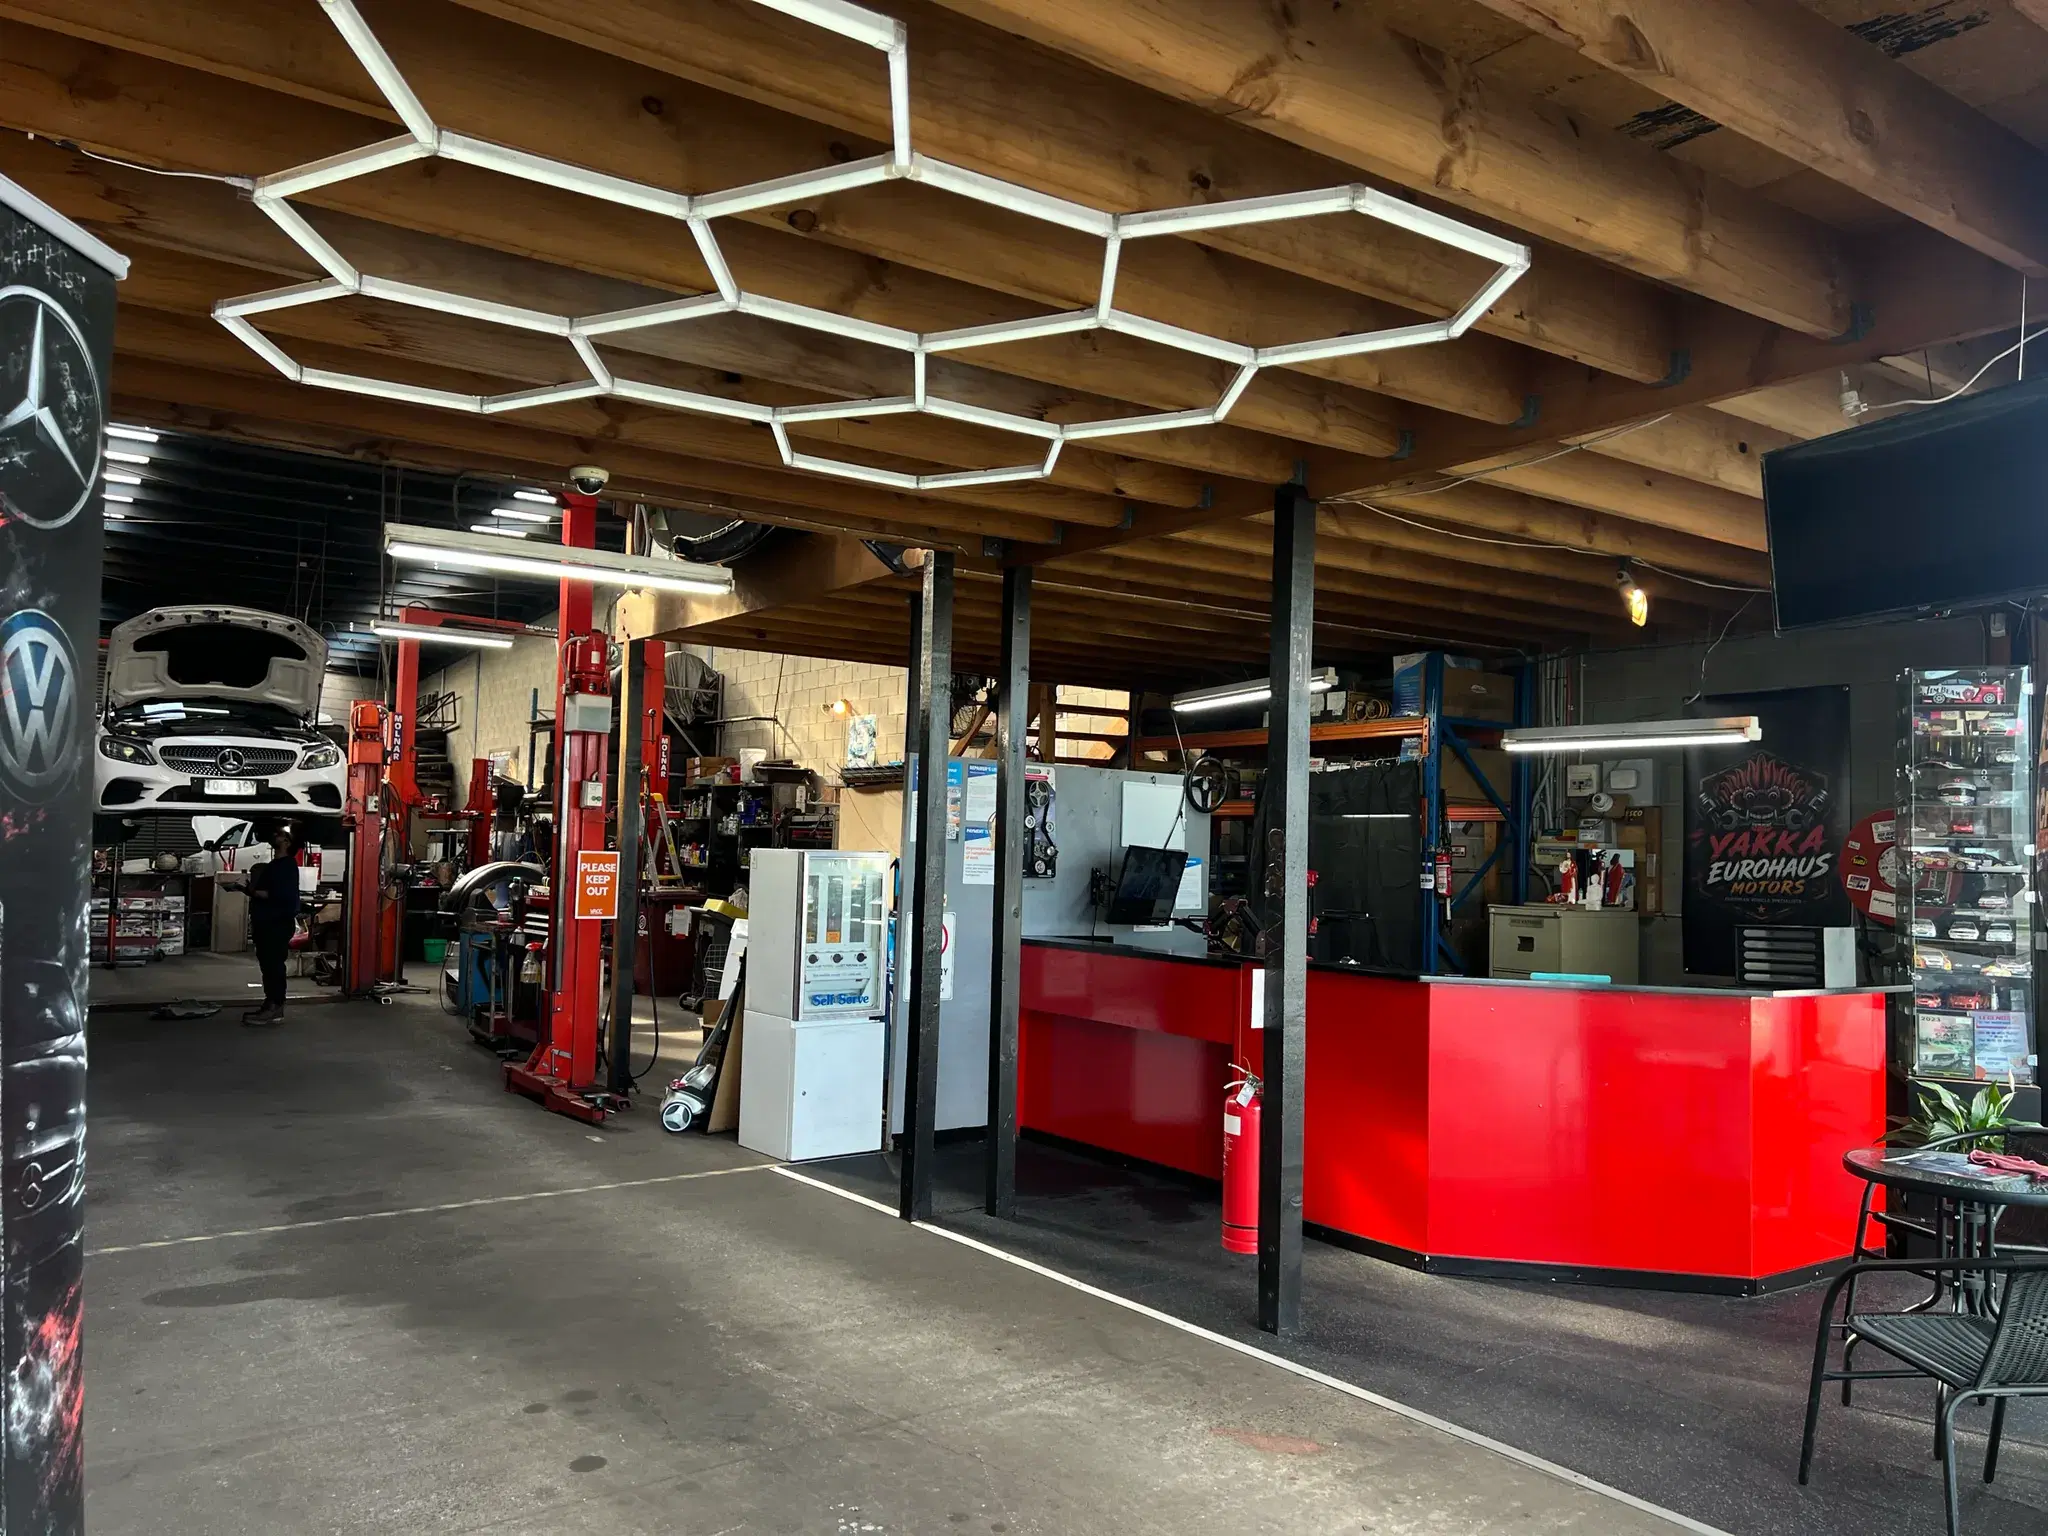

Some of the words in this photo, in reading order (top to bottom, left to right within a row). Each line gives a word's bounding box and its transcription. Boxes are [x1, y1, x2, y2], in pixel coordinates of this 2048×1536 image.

[393, 714, 402, 760] MOLNAR
[660, 737, 669, 778] MOLNAR
[1709, 824, 1824, 861] YAKKA
[581, 862, 617, 873] PLEASE
[1706, 852, 1834, 885] EUROHAUS
[585, 874, 611, 884] KEEP
[1731, 879, 1805, 896] MOTORS
[586, 886, 609, 896] OUT
[811, 994, 835, 1006] Self
[837, 993, 869, 1005] Serve
